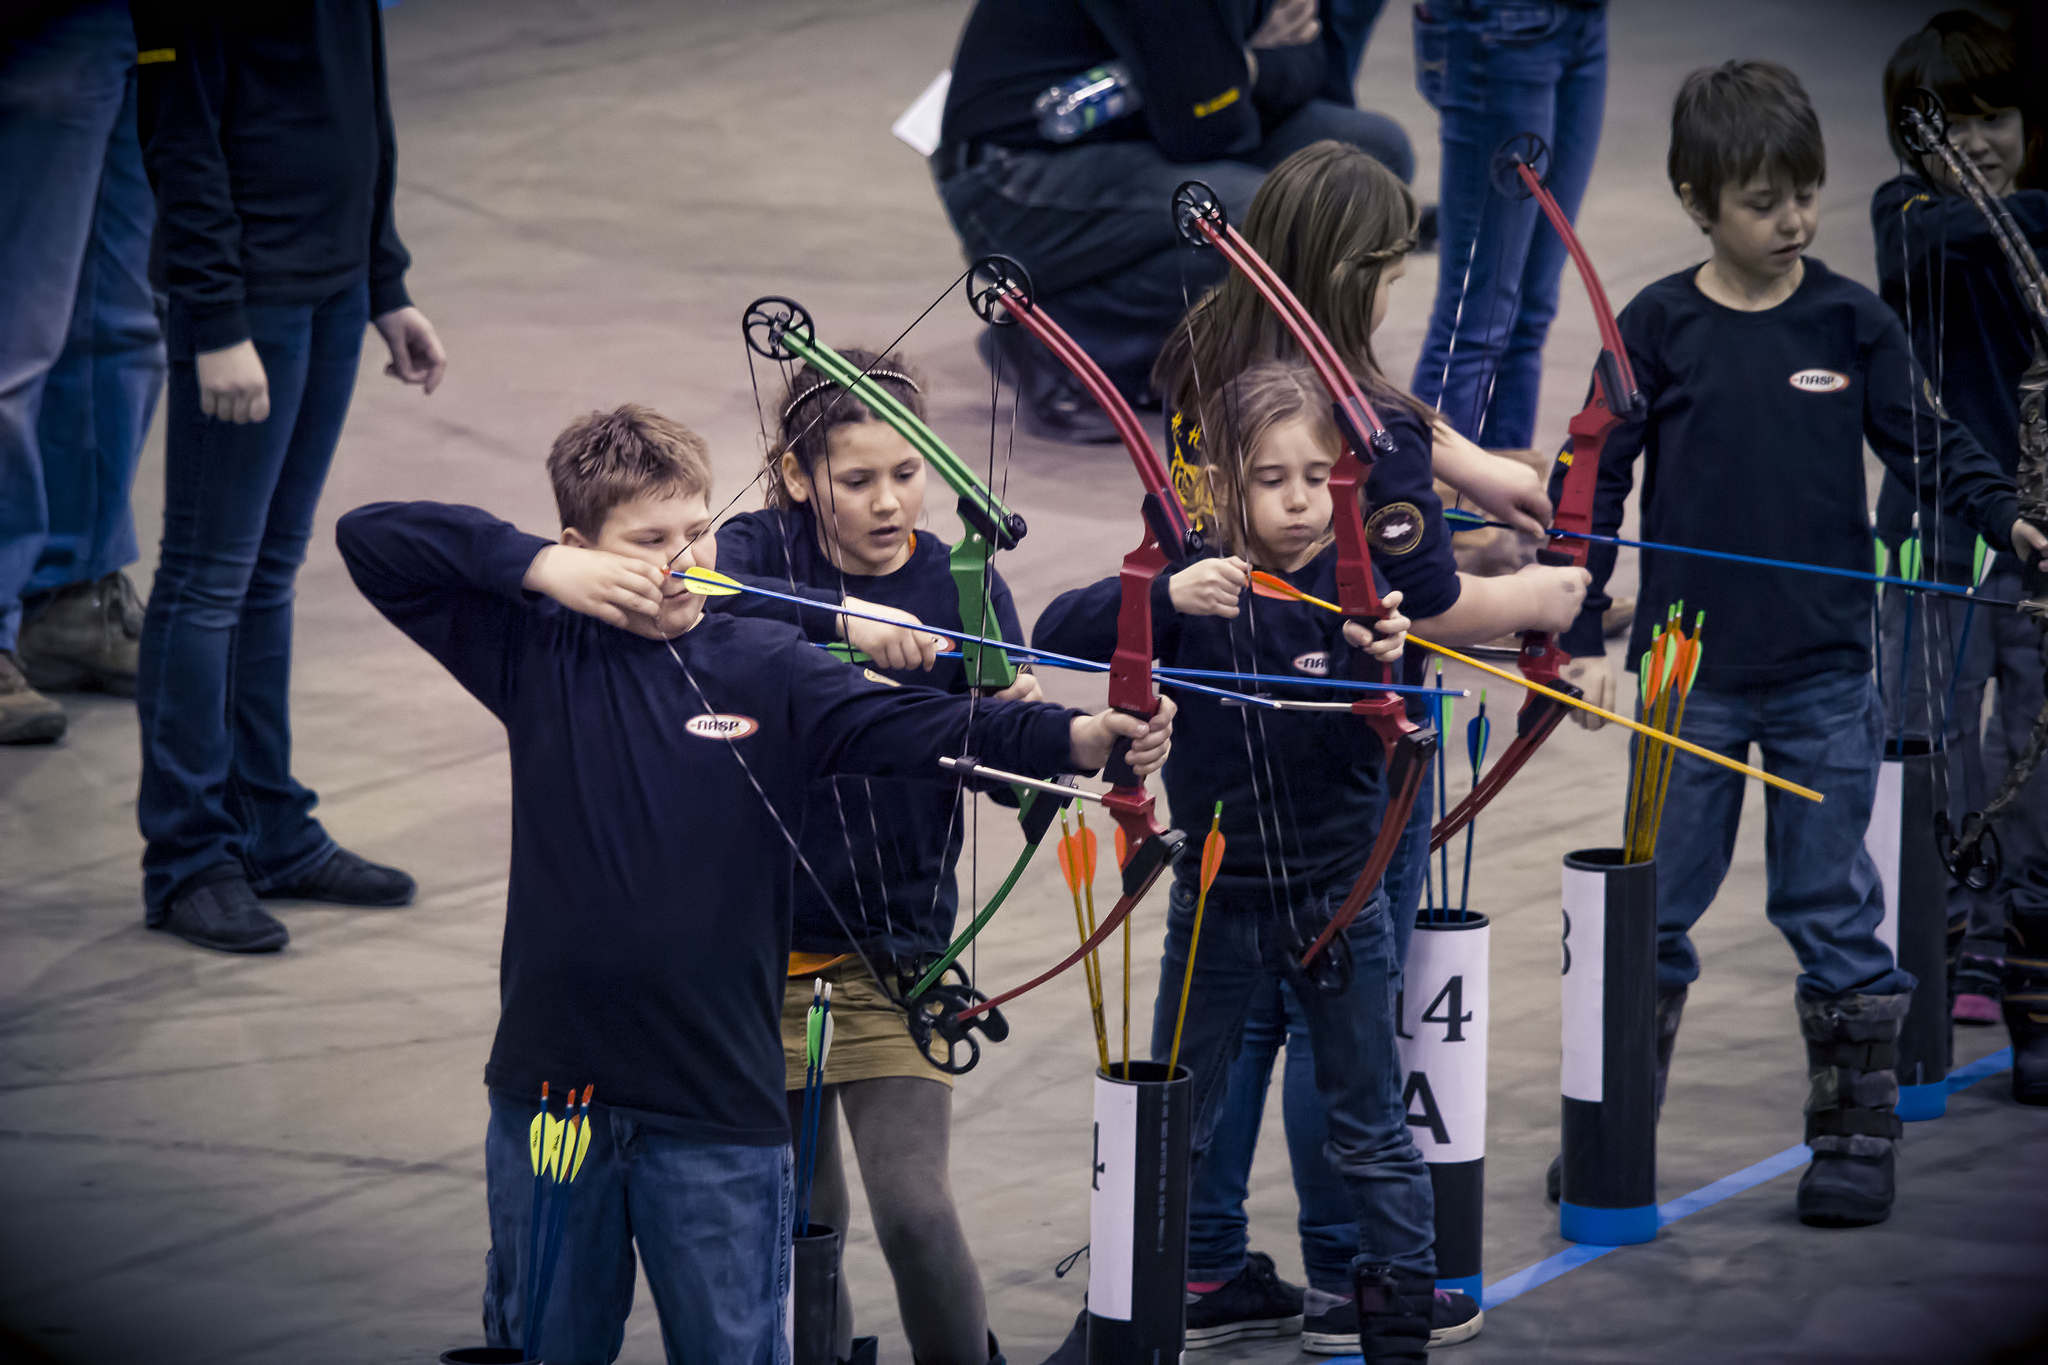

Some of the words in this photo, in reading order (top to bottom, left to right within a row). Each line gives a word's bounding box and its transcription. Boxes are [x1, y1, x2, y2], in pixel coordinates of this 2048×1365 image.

[1800, 375, 1835, 386] NASP
[1304, 658, 1326, 668] NA
[697, 720, 740, 731] NASP
[1402, 1071, 1451, 1144] A
